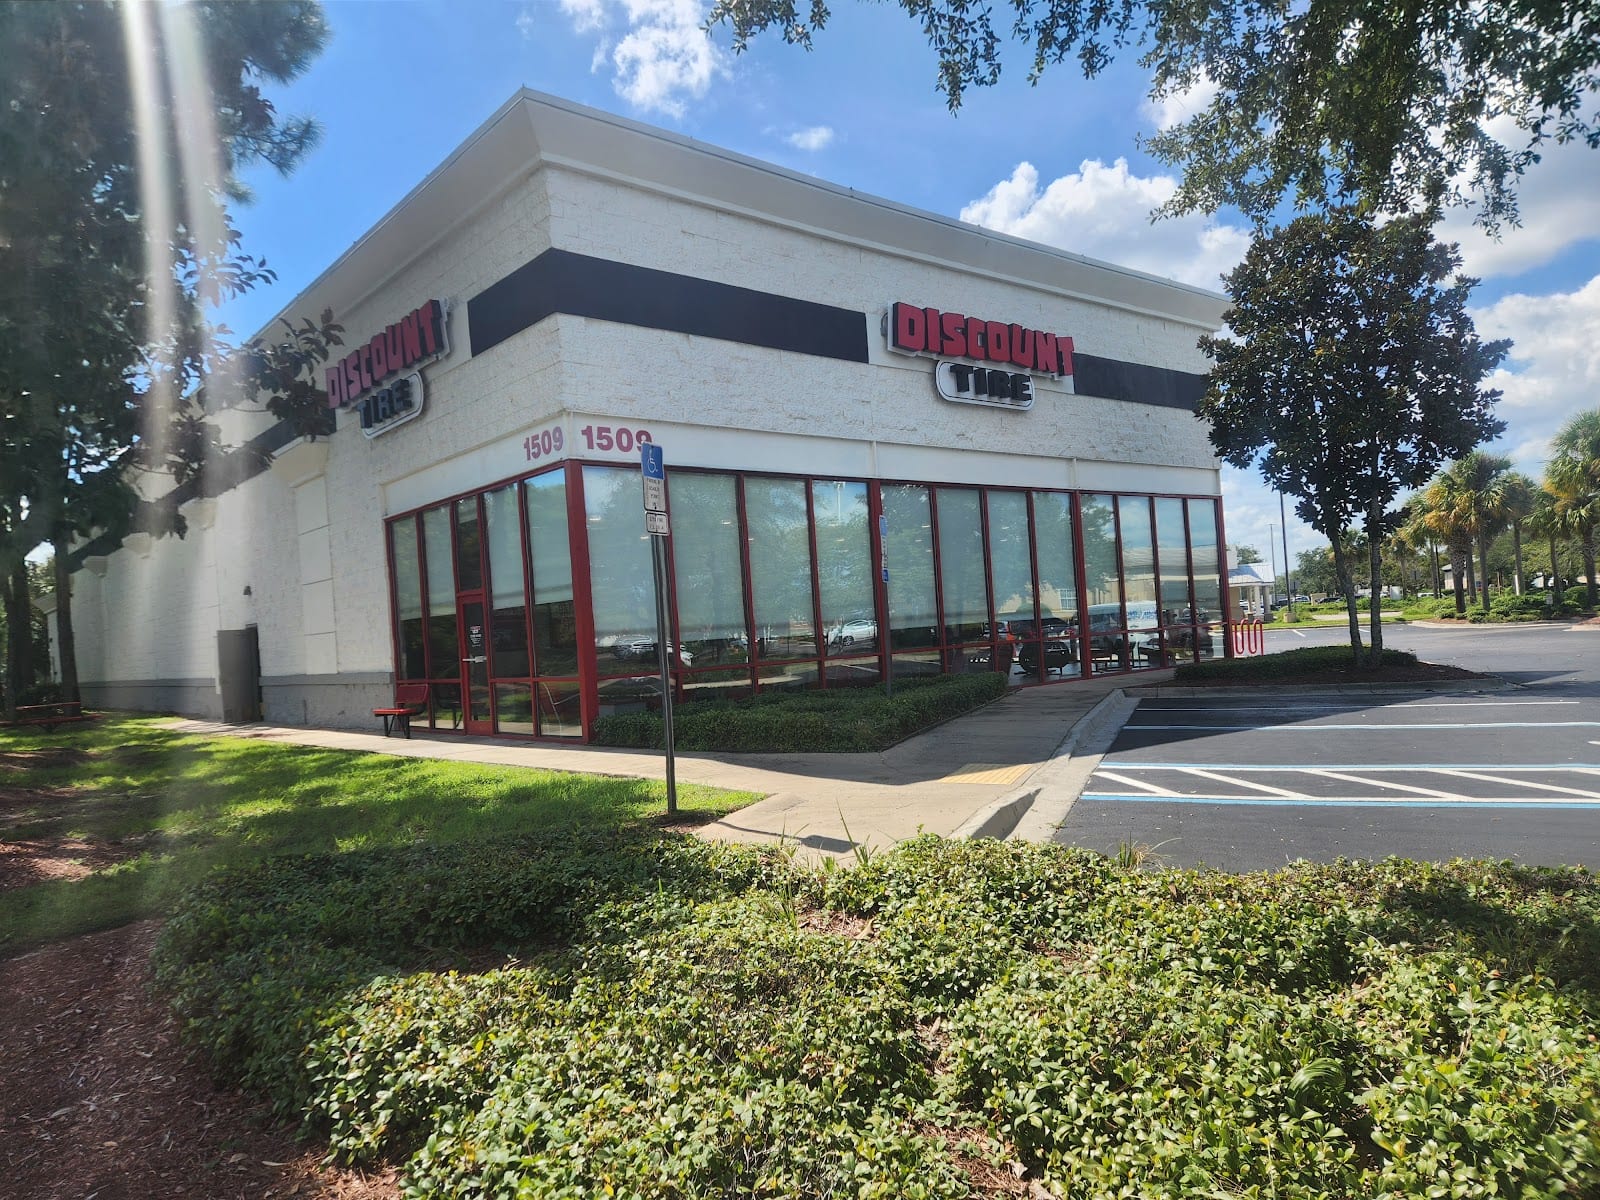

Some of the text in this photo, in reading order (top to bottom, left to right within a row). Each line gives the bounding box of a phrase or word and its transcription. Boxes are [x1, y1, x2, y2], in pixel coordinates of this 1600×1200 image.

[326, 299, 441, 409] DISCOUNT
[893, 302, 1074, 377] DISCOUNT
[356, 379, 412, 429] TIRE
[950, 364, 1032, 401] TIRE
[524, 426, 563, 461] 1509
